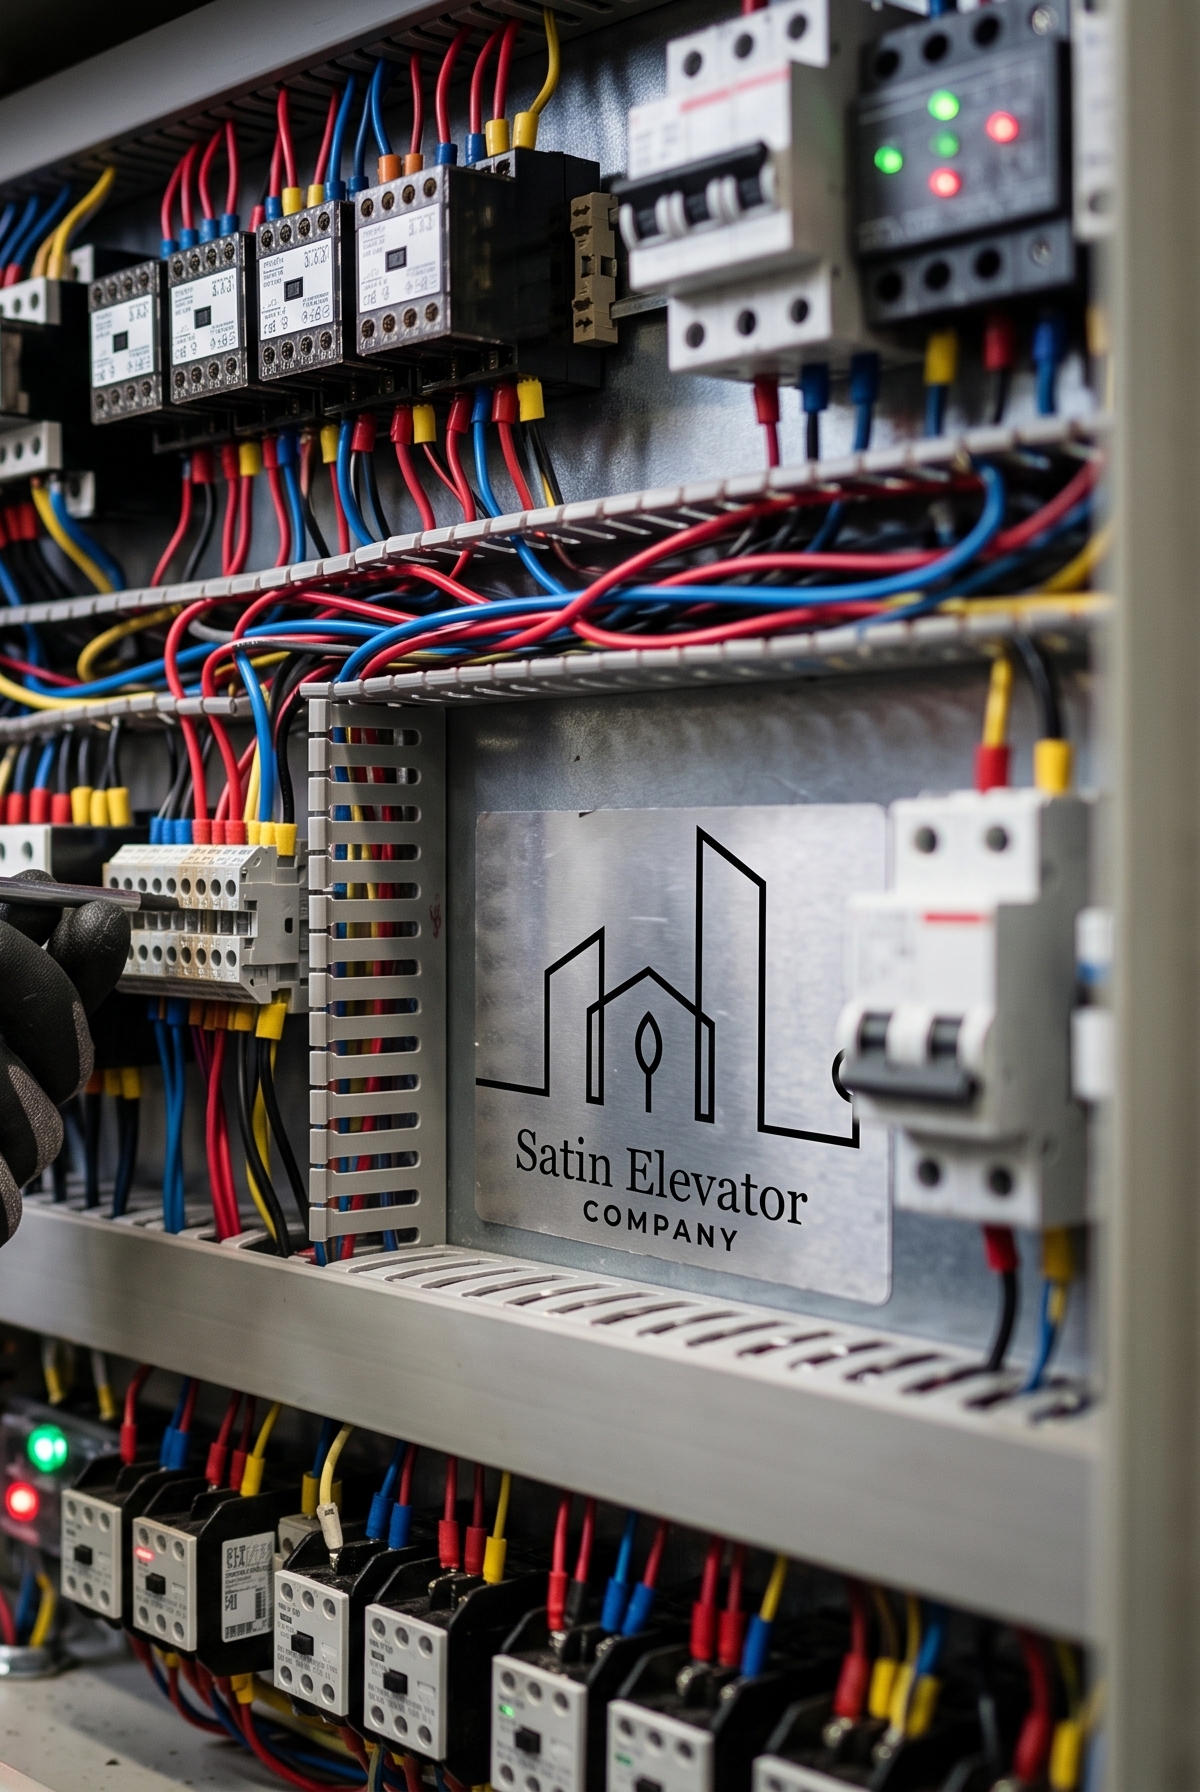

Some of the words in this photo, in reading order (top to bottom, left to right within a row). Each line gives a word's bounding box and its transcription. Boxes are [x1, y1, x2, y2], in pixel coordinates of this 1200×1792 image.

[516, 1129, 613, 1187] Satin
[626, 1147, 808, 1225] Elevator
[583, 1200, 738, 1251] COMPANY
